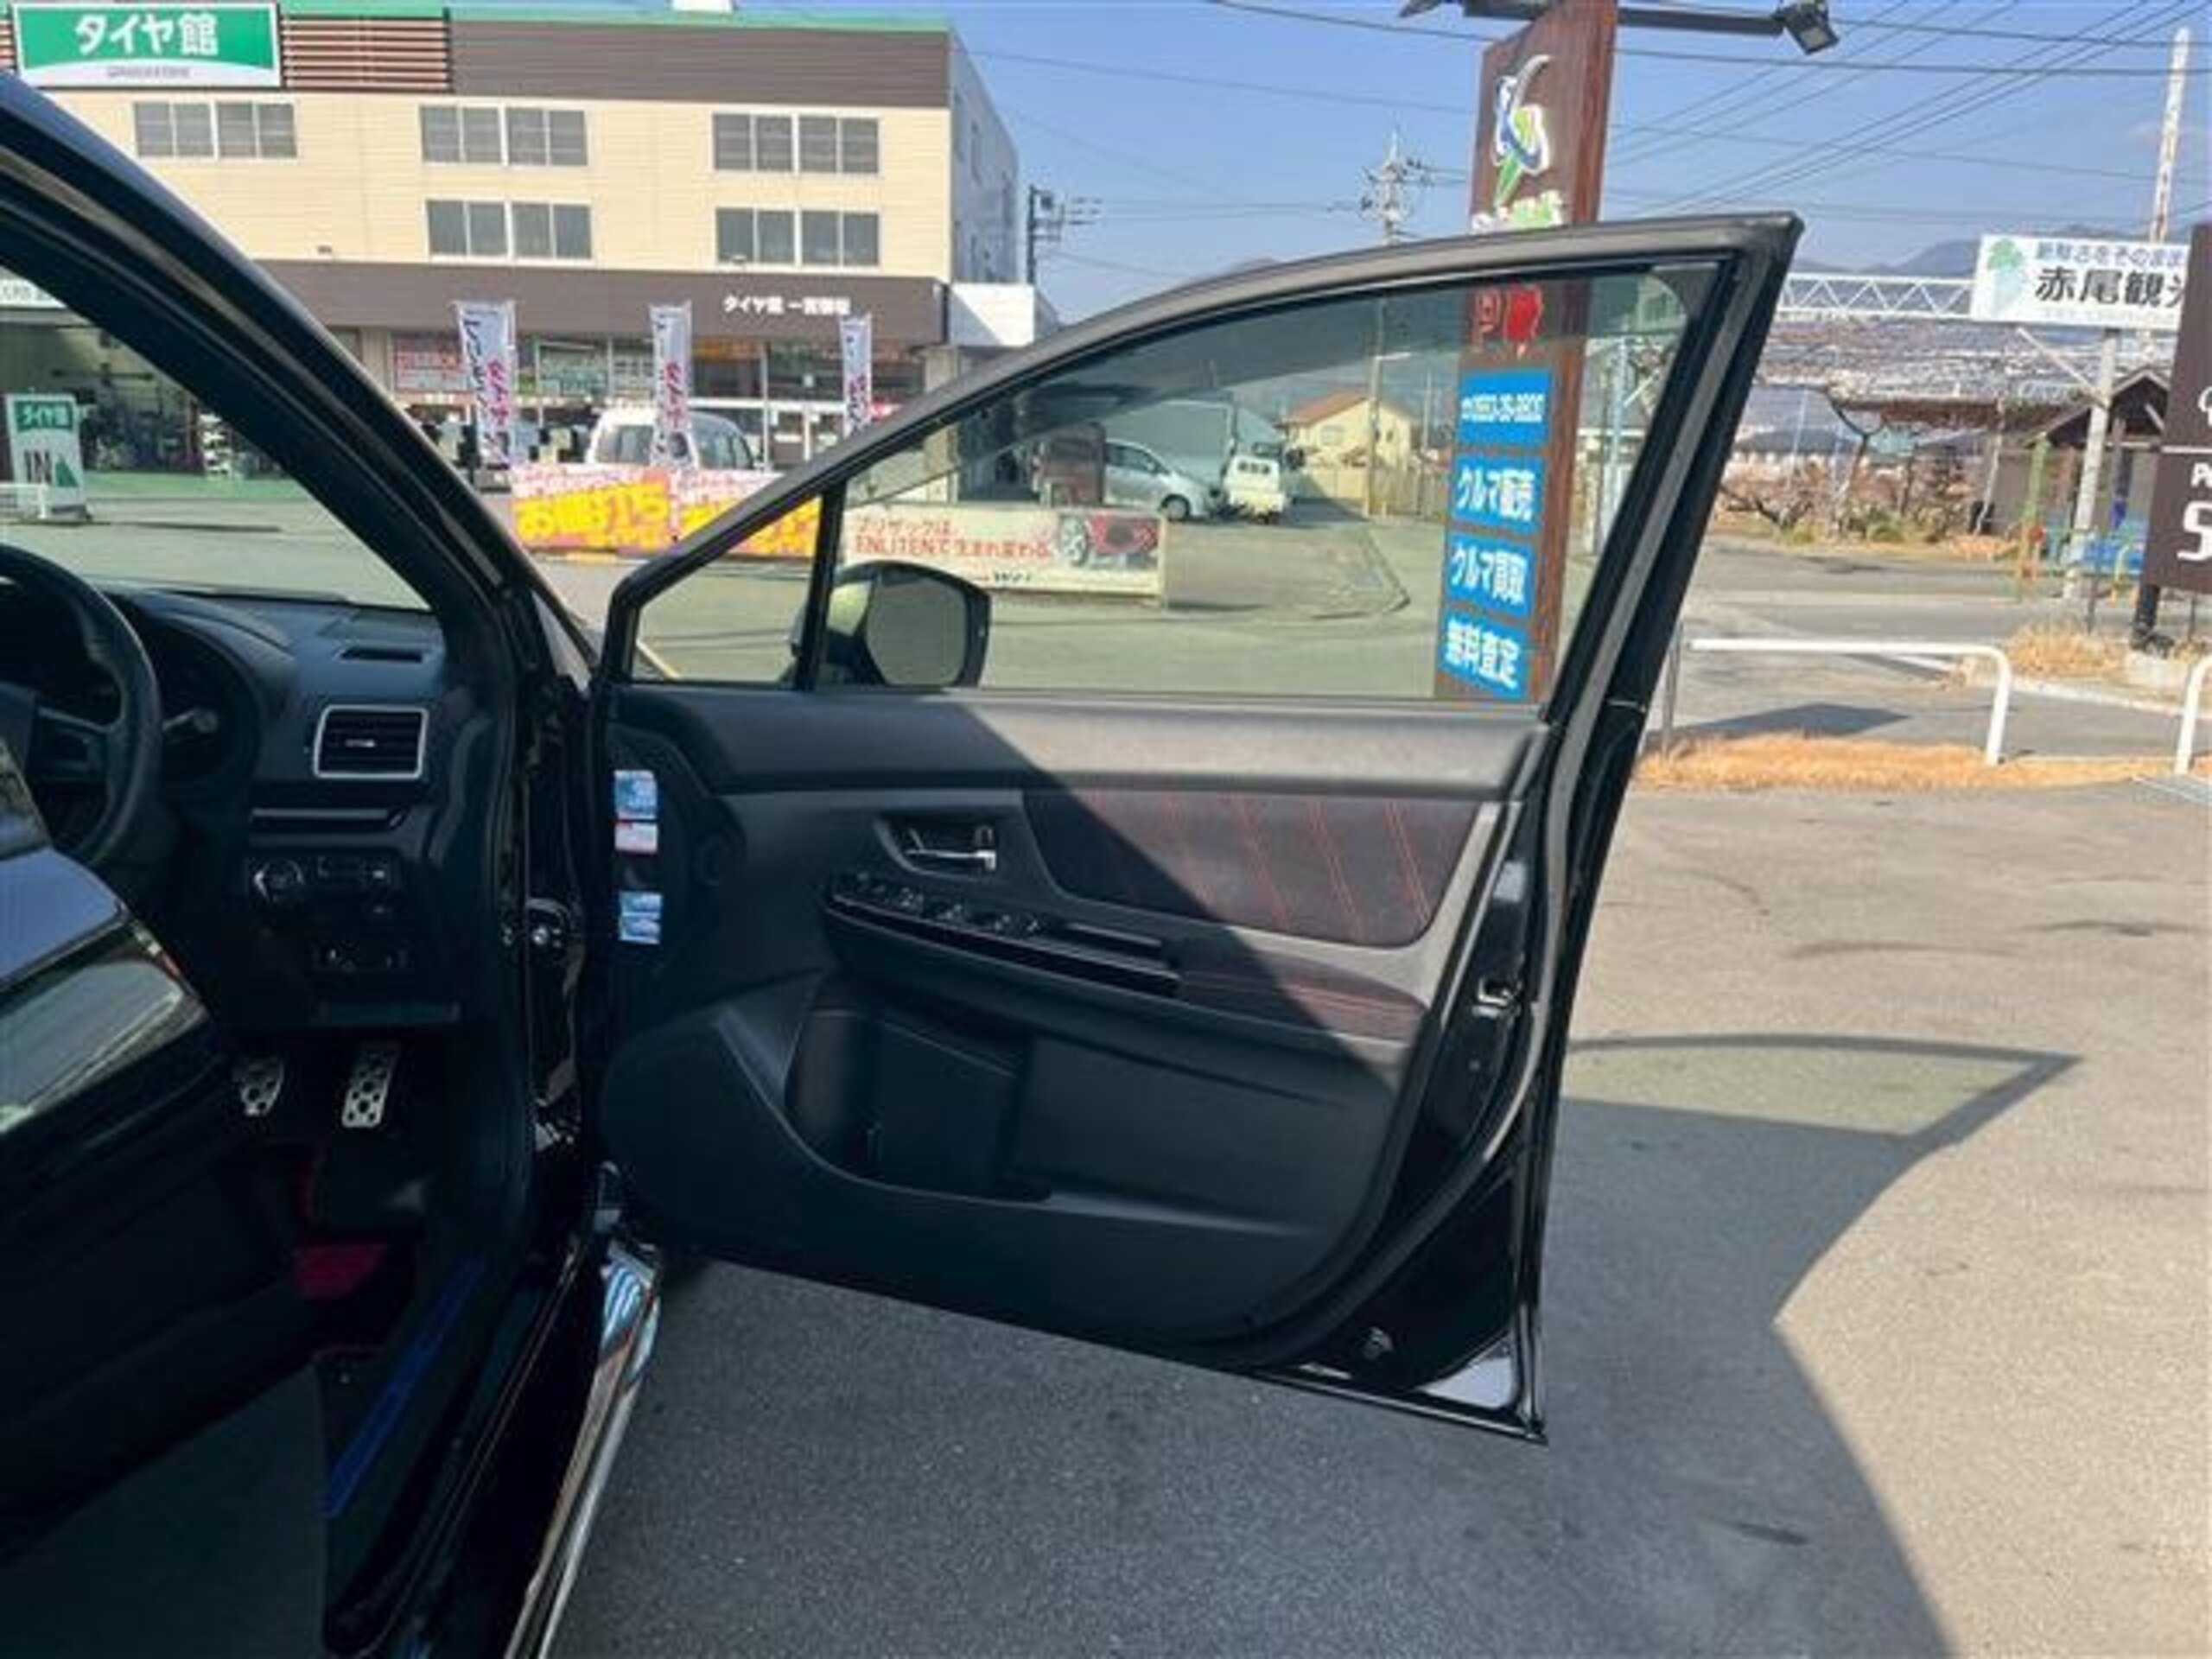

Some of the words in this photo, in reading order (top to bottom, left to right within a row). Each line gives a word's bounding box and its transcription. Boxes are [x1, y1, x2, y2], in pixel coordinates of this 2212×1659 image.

[75, 12, 219, 56] タイヤ館
[23, 449, 54, 486] IN
[1456, 466, 1535, 522] クルマ販売
[1451, 534, 1528, 605] クルマ買取
[1442, 617, 1521, 689] 無料査定
